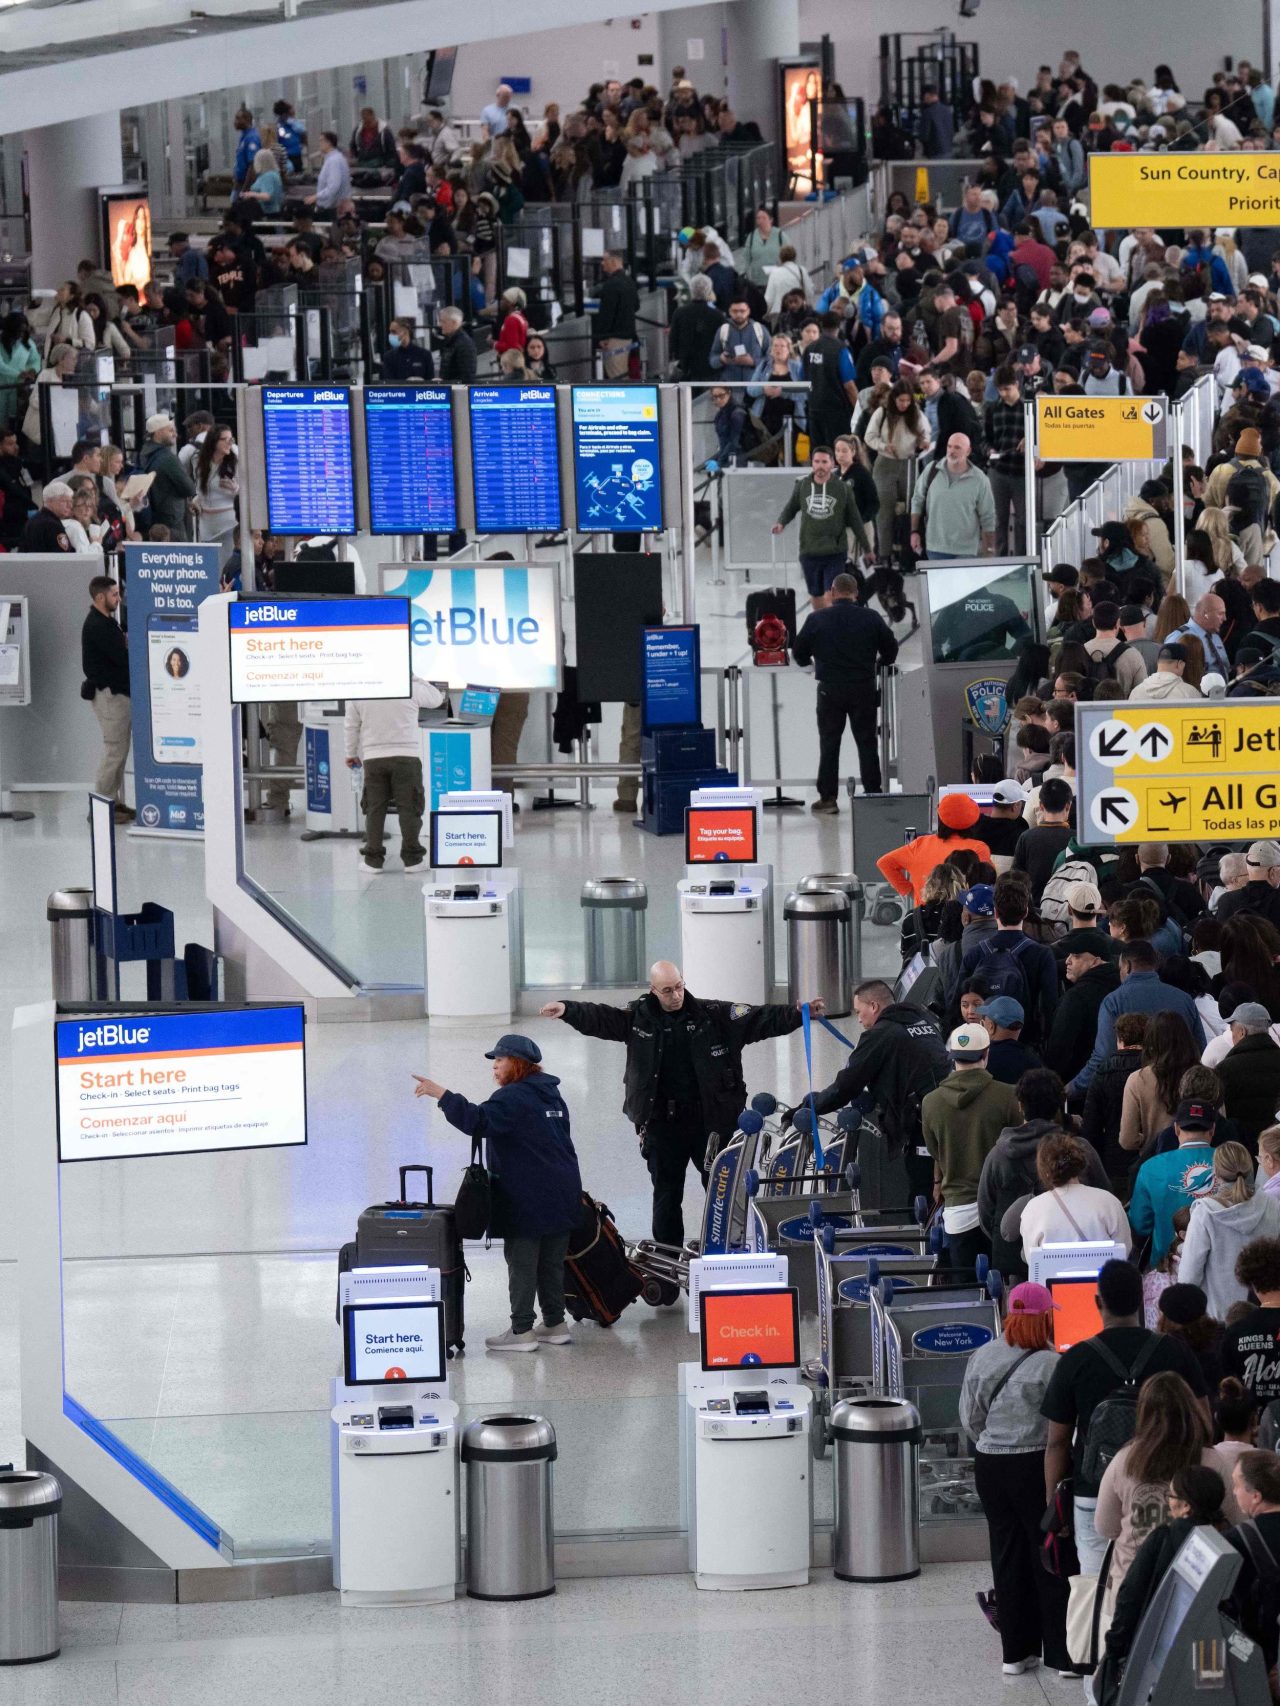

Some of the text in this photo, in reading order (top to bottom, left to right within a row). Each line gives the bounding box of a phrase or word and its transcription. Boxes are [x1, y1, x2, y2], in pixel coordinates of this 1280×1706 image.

[1140, 167, 1171, 181] Sun
[1177, 165, 1250, 182] Country,
[313, 391, 345, 402] jetBlue
[368, 390, 447, 402] Departures jetBlue
[520, 390, 551, 401] jetBlue
[1044, 406, 1105, 419] All Gates
[141, 552, 204, 566] Everything is
[138, 568, 209, 581] on your phone.
[150, 582, 197, 595] Now your
[154, 597, 195, 609] ID is too.
[965, 603, 995, 612] POLICE
[244, 605, 298, 625] jetBlue
[412, 607, 539, 646] etBlue
[246, 638, 323, 652] Start here
[246, 671, 300, 681] Comenzar
[970, 683, 982, 692] PORT
[972, 686, 1006, 700] POLIC
[1202, 784, 1244, 811] All
[1203, 818, 1243, 831] Todas
[1246, 817, 1266, 830] las
[445, 832, 487, 840] Start here.
[699, 828, 743, 837] Tag your bag.
[907, 1025, 937, 1038] POLICE
[77, 1024, 151, 1053] jetBlue
[80, 1067, 187, 1089] Start here
[80, 1082, 240, 1101] Check-in Select seats Print bag tags
[80, 1110, 187, 1130] Comenzar aquí
[112, 1130, 148, 1138] Seleccionar
[204, 1124, 233, 1133] etiquetas
[711, 1166, 731, 1246] smartecarte
[720, 1324, 780, 1338] Check in.
[366, 1333, 423, 1344] Start here.
[934, 1337, 973, 1347] New York
[1238, 1334, 1265, 1345] KINGS
[364, 1345, 424, 1355] Comience aquí.
[1237, 1341, 1274, 1352] QUEENS
